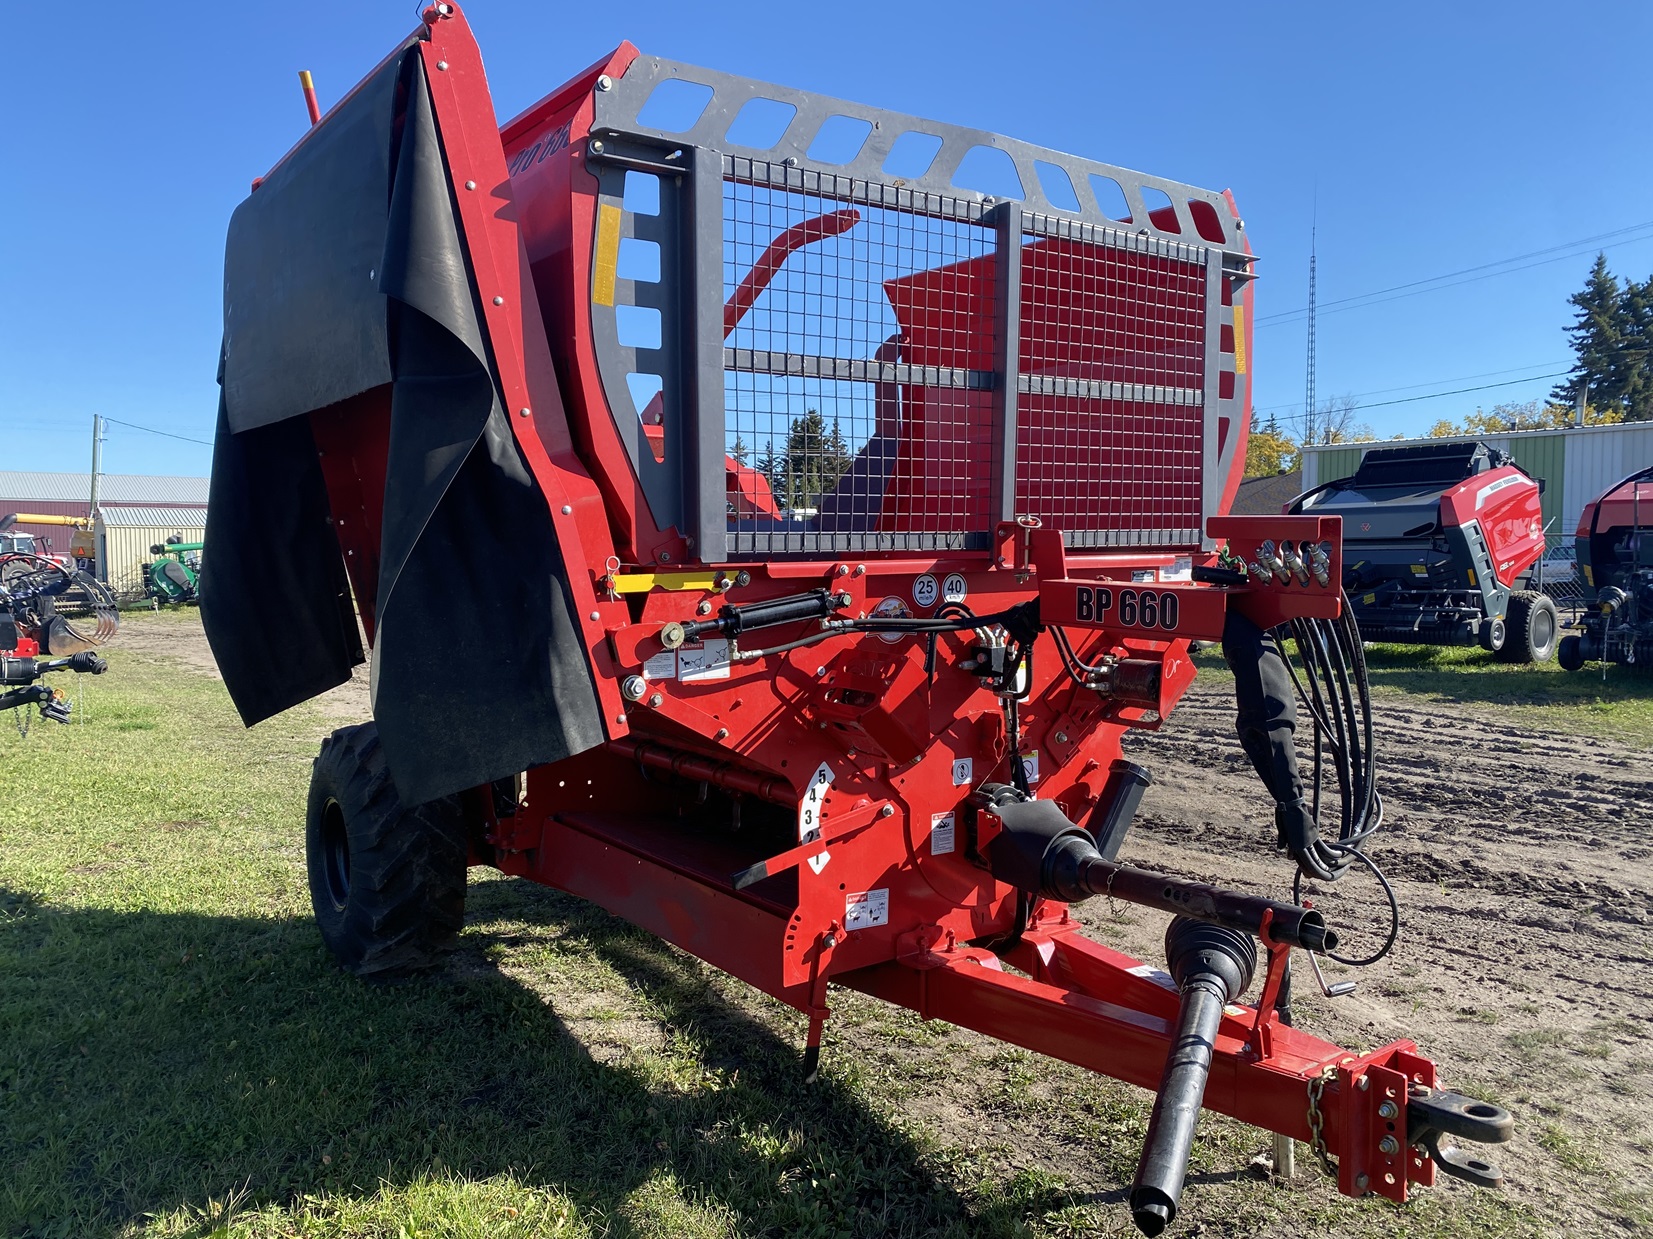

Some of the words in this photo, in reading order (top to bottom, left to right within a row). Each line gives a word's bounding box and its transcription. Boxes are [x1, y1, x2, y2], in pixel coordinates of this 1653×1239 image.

[918, 580, 934, 594] 25
[947, 580, 962, 594] 40
[1076, 586, 1113, 623] BP
[1118, 588, 1179, 631] 660
[818, 769, 826, 785] 5
[809, 788, 817, 803] 4
[805, 809, 813, 825] 3
